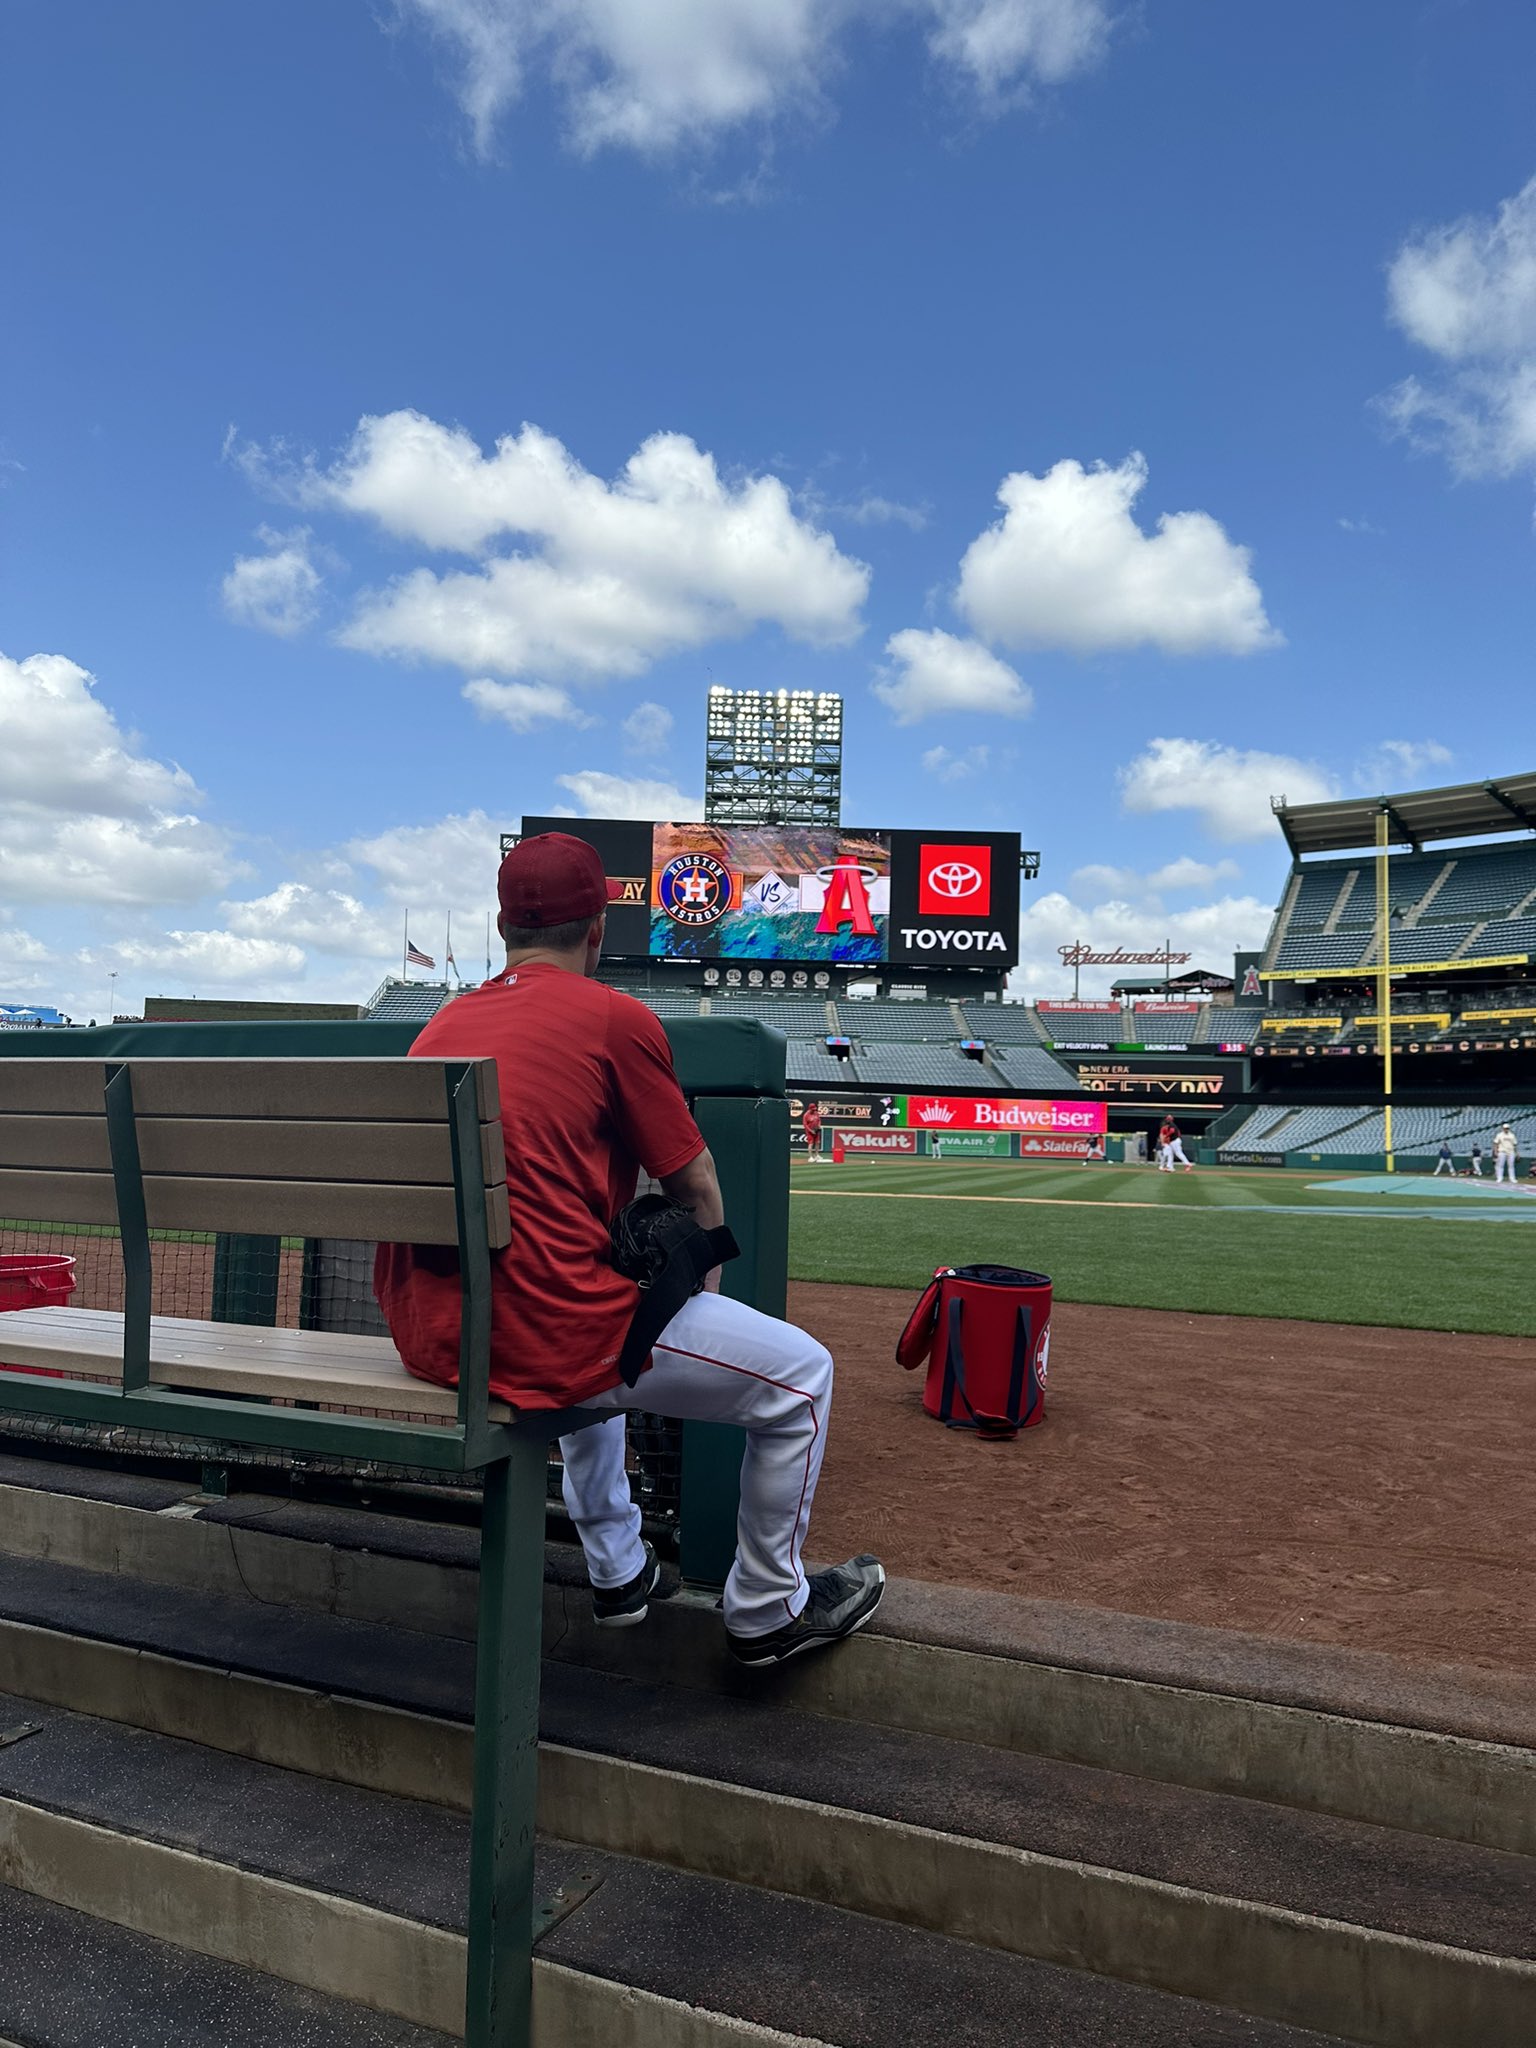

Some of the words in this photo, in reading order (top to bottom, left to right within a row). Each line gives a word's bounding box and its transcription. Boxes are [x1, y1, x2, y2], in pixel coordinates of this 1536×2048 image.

[667, 856, 724, 877] HOUSTON
[619, 883, 645, 900] AY
[682, 877, 709, 902] H
[760, 881, 781, 903] VS
[815, 855, 878, 935] A
[669, 905, 720, 922] ASTROS
[900, 929, 1007, 952] TOYOTA
[1058, 944, 1192, 967] Budweiser
[1144, 1002, 1190, 1012] Budweiser
[1144, 1043, 1167, 1051] LAUNCH
[1111, 1066, 1130, 1074] ERA
[855, 1107, 872, 1116] DAY
[974, 1103, 1095, 1127] Budweiser
[839, 1133, 912, 1148] Yakult
[962, 1138, 983, 1146] AIR
[1219, 1153, 1282, 1164] HeGetsUs.com
